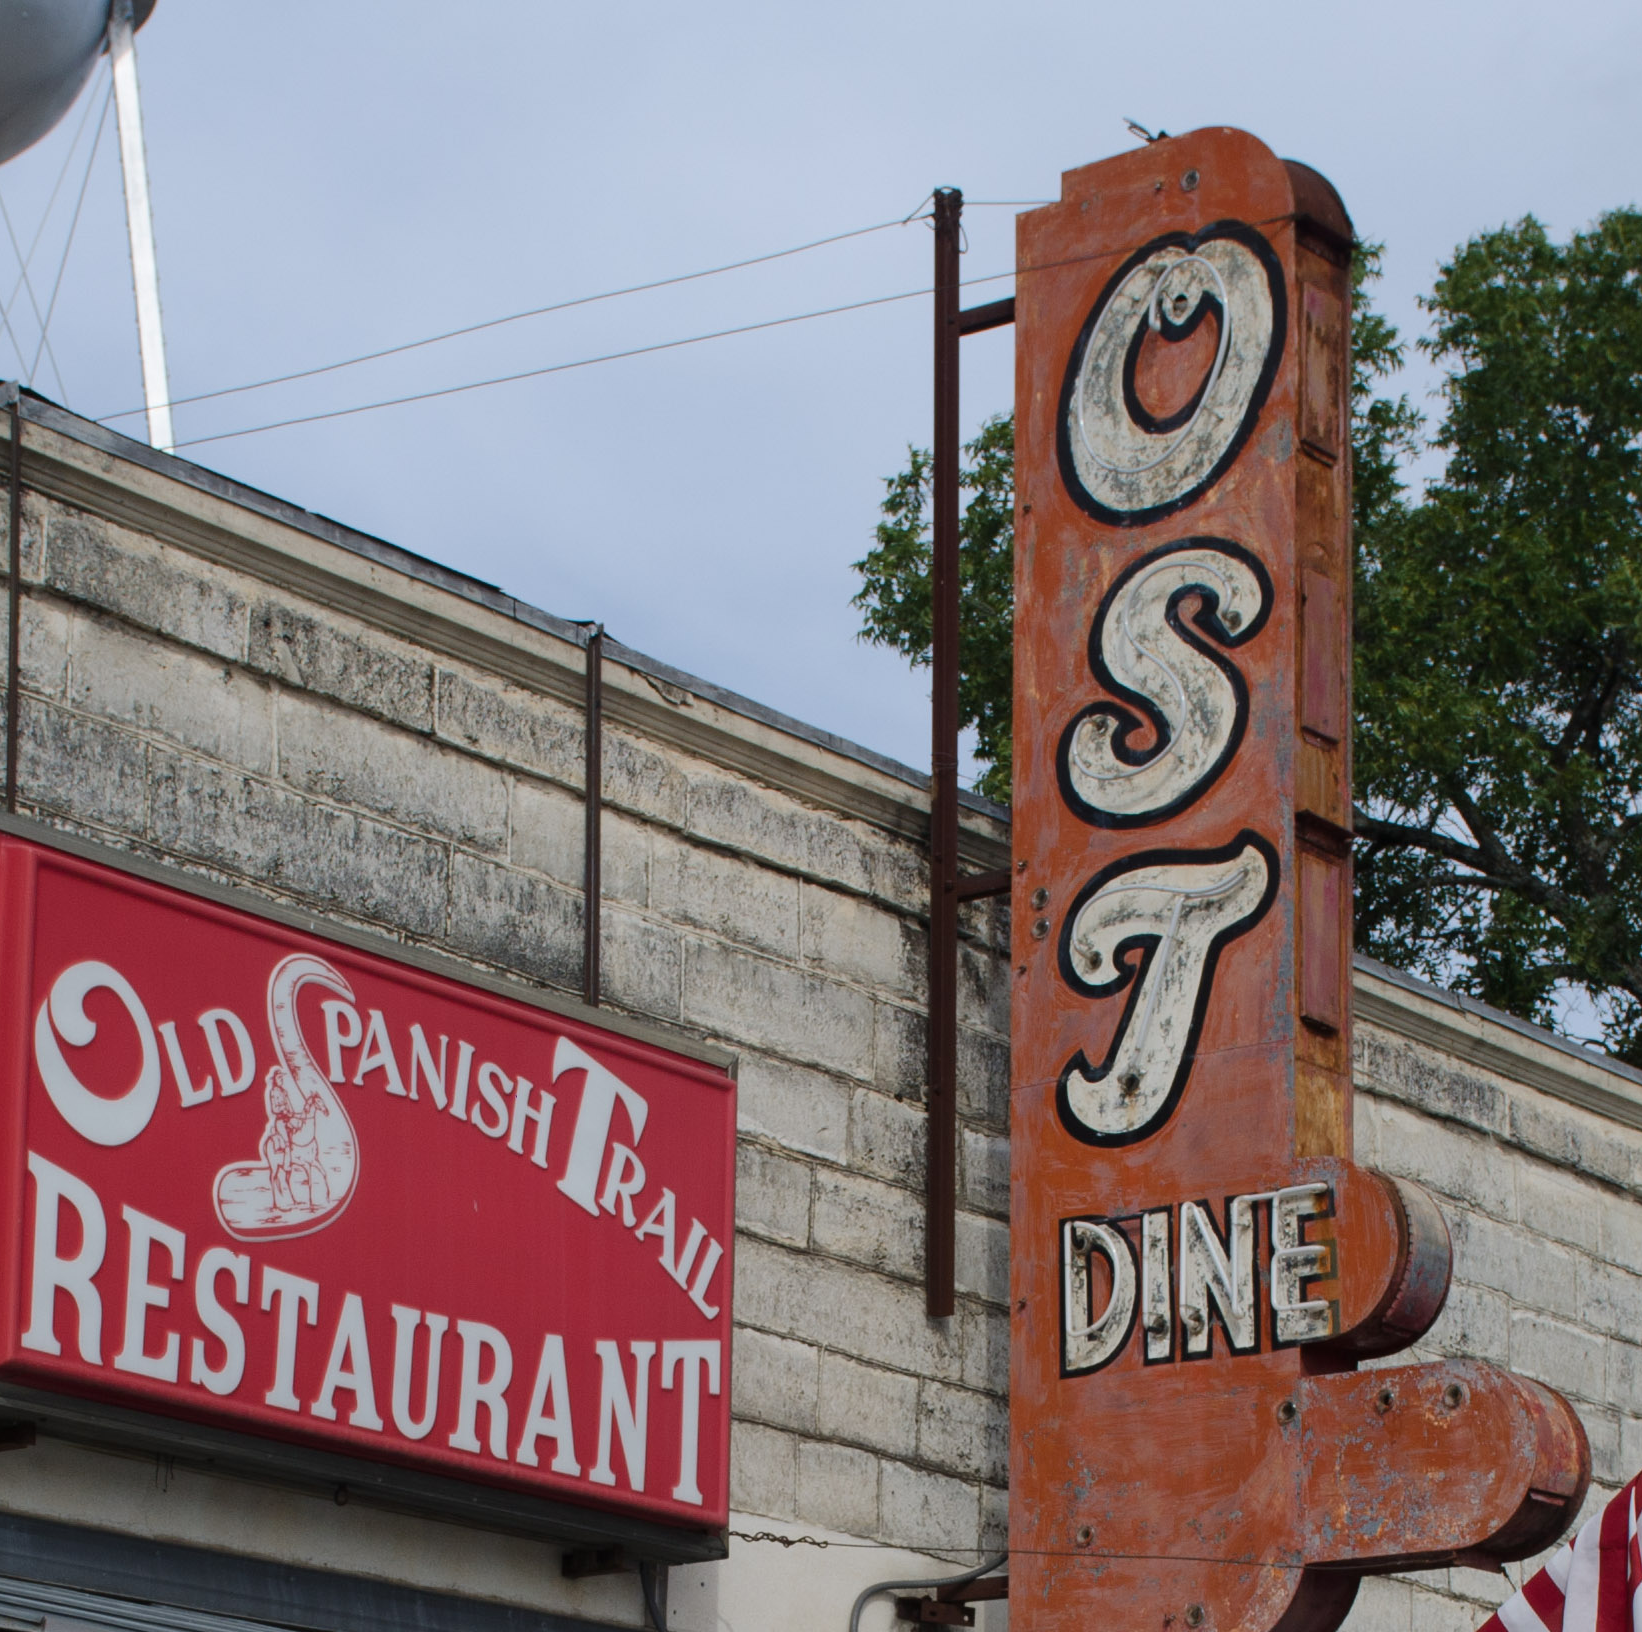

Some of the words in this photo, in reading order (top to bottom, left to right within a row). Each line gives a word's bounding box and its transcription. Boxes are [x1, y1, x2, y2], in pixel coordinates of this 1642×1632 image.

[34, 960, 257, 1147] OLD
[213, 953, 556, 1242] SPANISH
[551, 1036, 724, 1321] TRAIL
[1060, 1182, 1336, 1378] DINE
[21, 1151, 722, 1506] RESTAURANT
